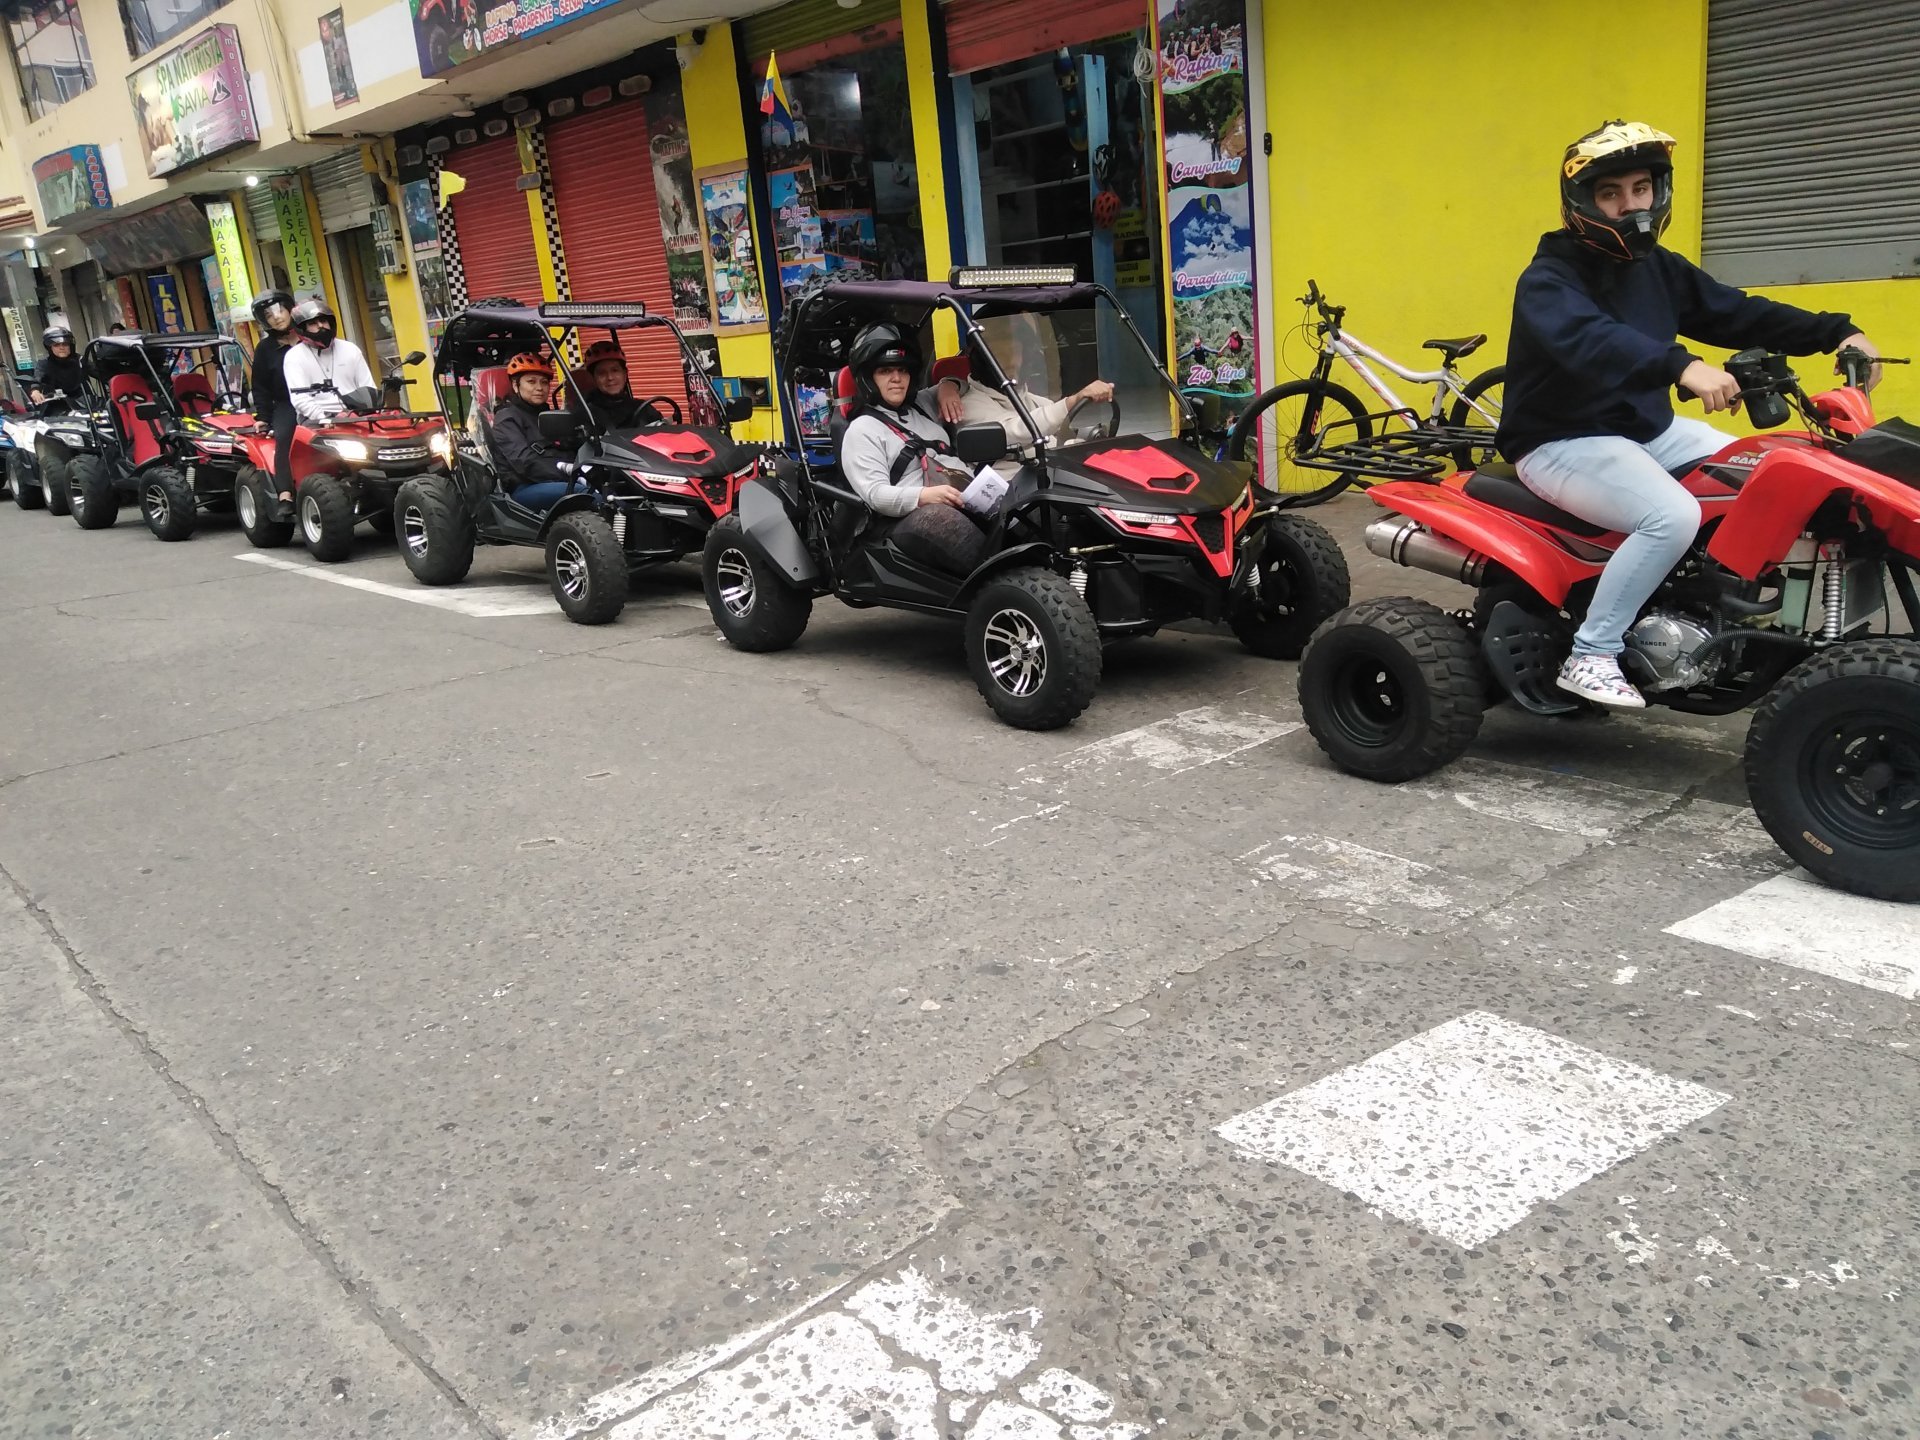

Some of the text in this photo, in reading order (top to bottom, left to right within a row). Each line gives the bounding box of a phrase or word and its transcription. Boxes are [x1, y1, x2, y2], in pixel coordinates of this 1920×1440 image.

[483, 22, 508, 47] HORSE
[513, 4, 554, 35] PARAPENTE
[156, 38, 224, 95] SPA NATURISTA
[1173, 52, 1234, 81] Rafting
[178, 86, 211, 118] SAVIA
[1172, 157, 1242, 183] Canyoning
[277, 189, 305, 286] MASAJES
[292, 188, 318, 286] ESPECIALES
[668, 233, 699, 249] CAYONING
[212, 218, 238, 303] MASAJES
[1176, 271, 1247, 291] Paragliding
[674, 308, 693, 319] MOTOS
[1188, 362, 1246, 385] Zip Line
[1728, 455, 1761, 466] RAN
